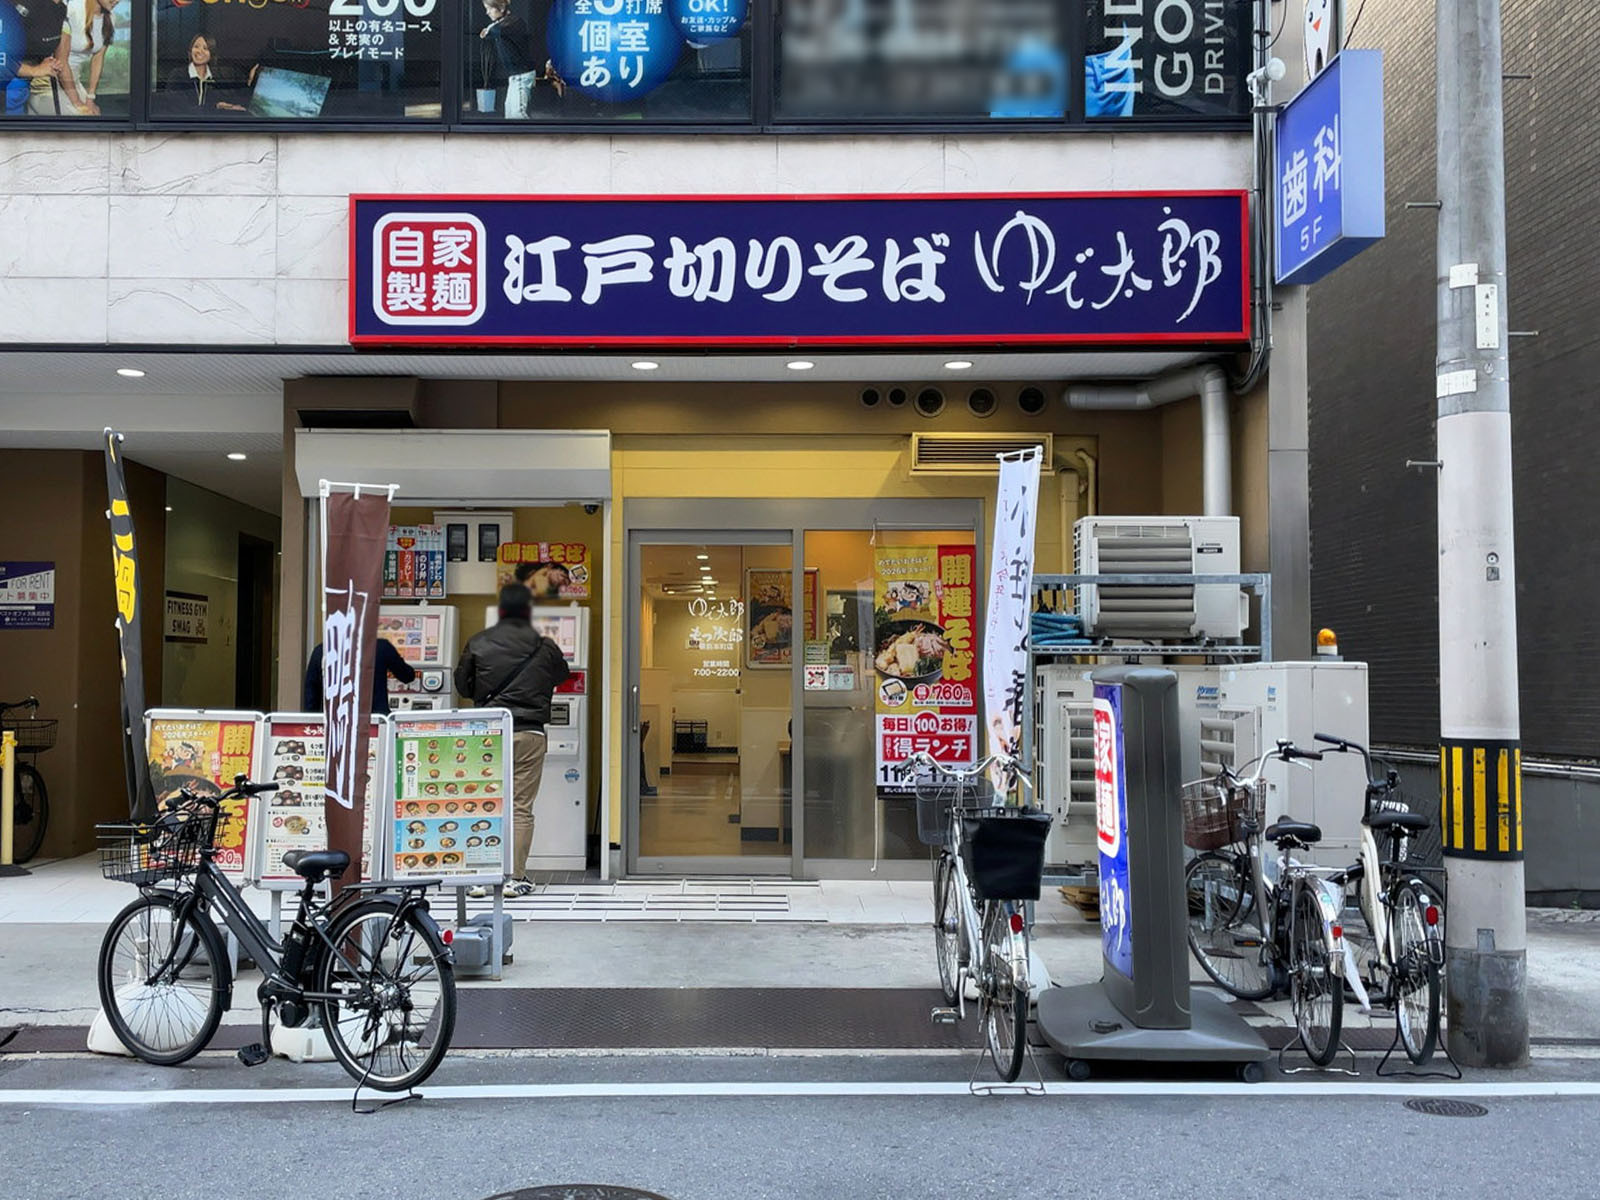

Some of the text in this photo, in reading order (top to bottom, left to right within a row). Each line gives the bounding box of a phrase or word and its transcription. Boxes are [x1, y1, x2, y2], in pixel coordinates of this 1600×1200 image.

[328, 20, 432, 32] 以上の有名コース
[328, 33, 384, 45] & 充実の
[578, 20, 650, 52] 個室
[329, 47, 404, 59] プレイモード
[580, 55, 644, 88] あり
[1282, 113, 1342, 228] 歯科
[387, 227, 473, 268] 自家
[502, 206, 1223, 323] 江戸切りそば ゆで太郎
[386, 271, 473, 313] 製麺
[168, 600, 208, 616] FITNESS GYM
[882, 717, 909, 731] 毎日
